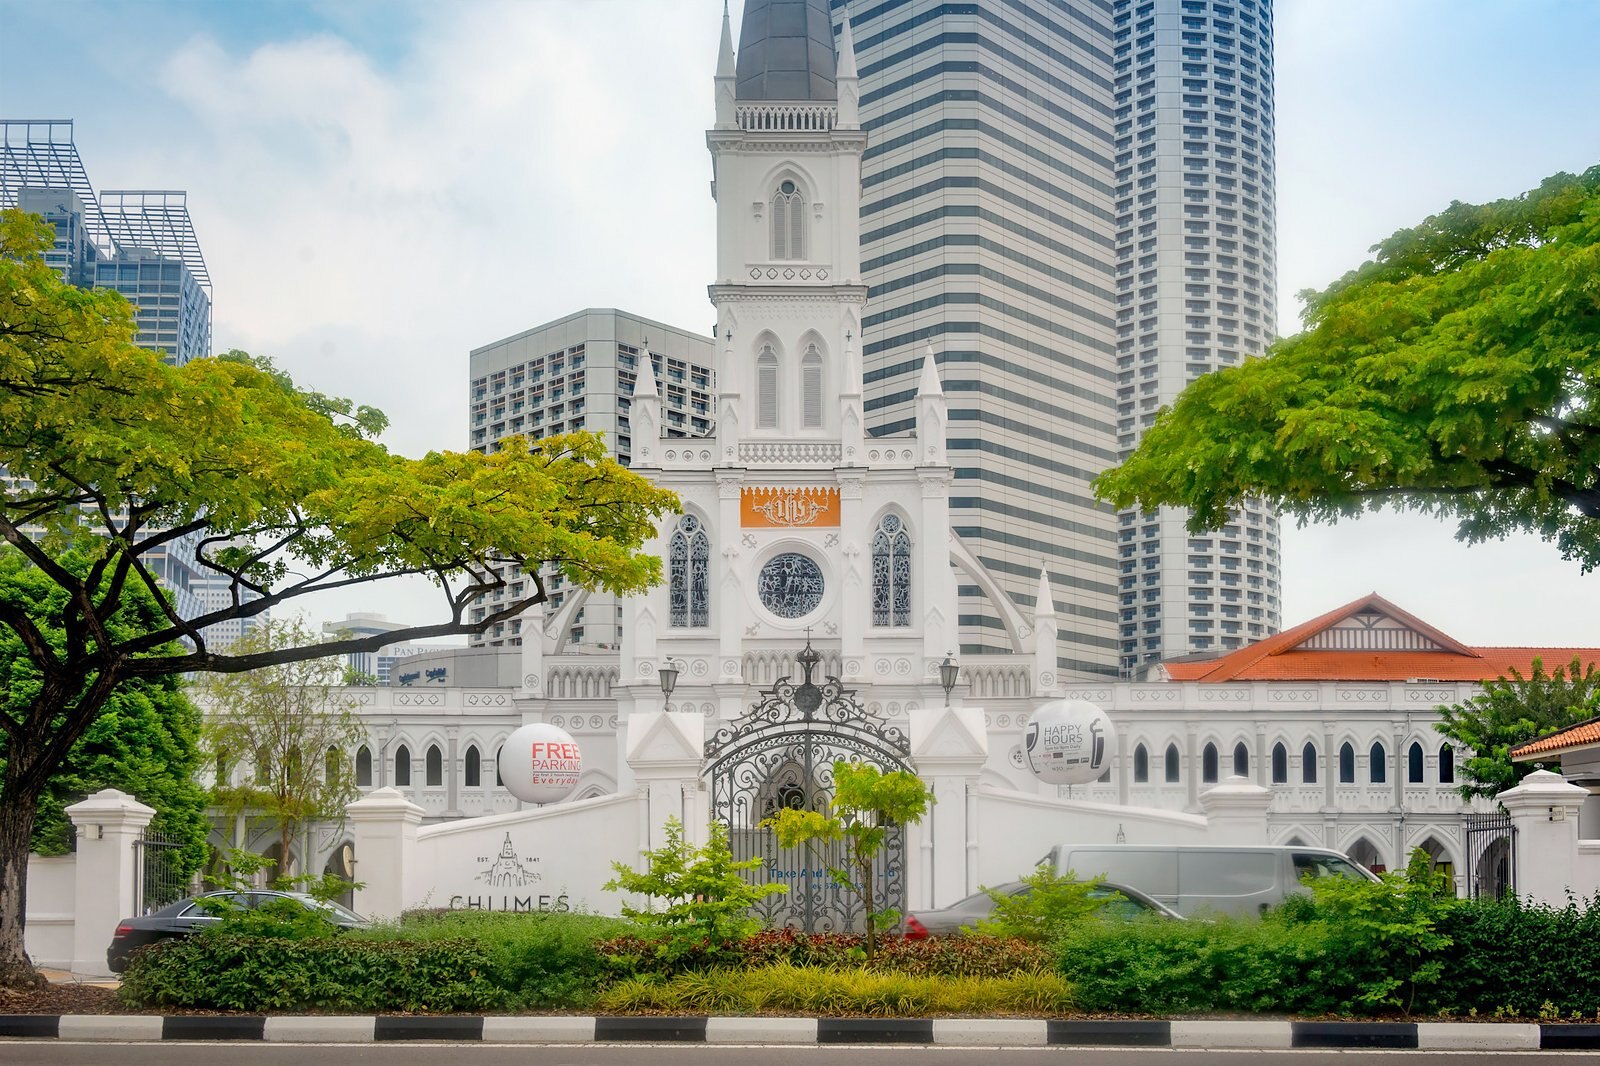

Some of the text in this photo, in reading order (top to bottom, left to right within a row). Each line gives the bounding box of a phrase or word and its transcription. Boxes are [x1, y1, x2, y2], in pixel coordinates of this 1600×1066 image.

[394, 647, 414, 657] PAN
[1044, 725, 1081, 736] HAPPY
[1043, 734, 1083, 745] HOURS
[532, 743, 580, 759] FREE
[532, 759, 580, 770] PARKING
[770, 868, 797, 878] Take
[800, 868, 823, 878] And
